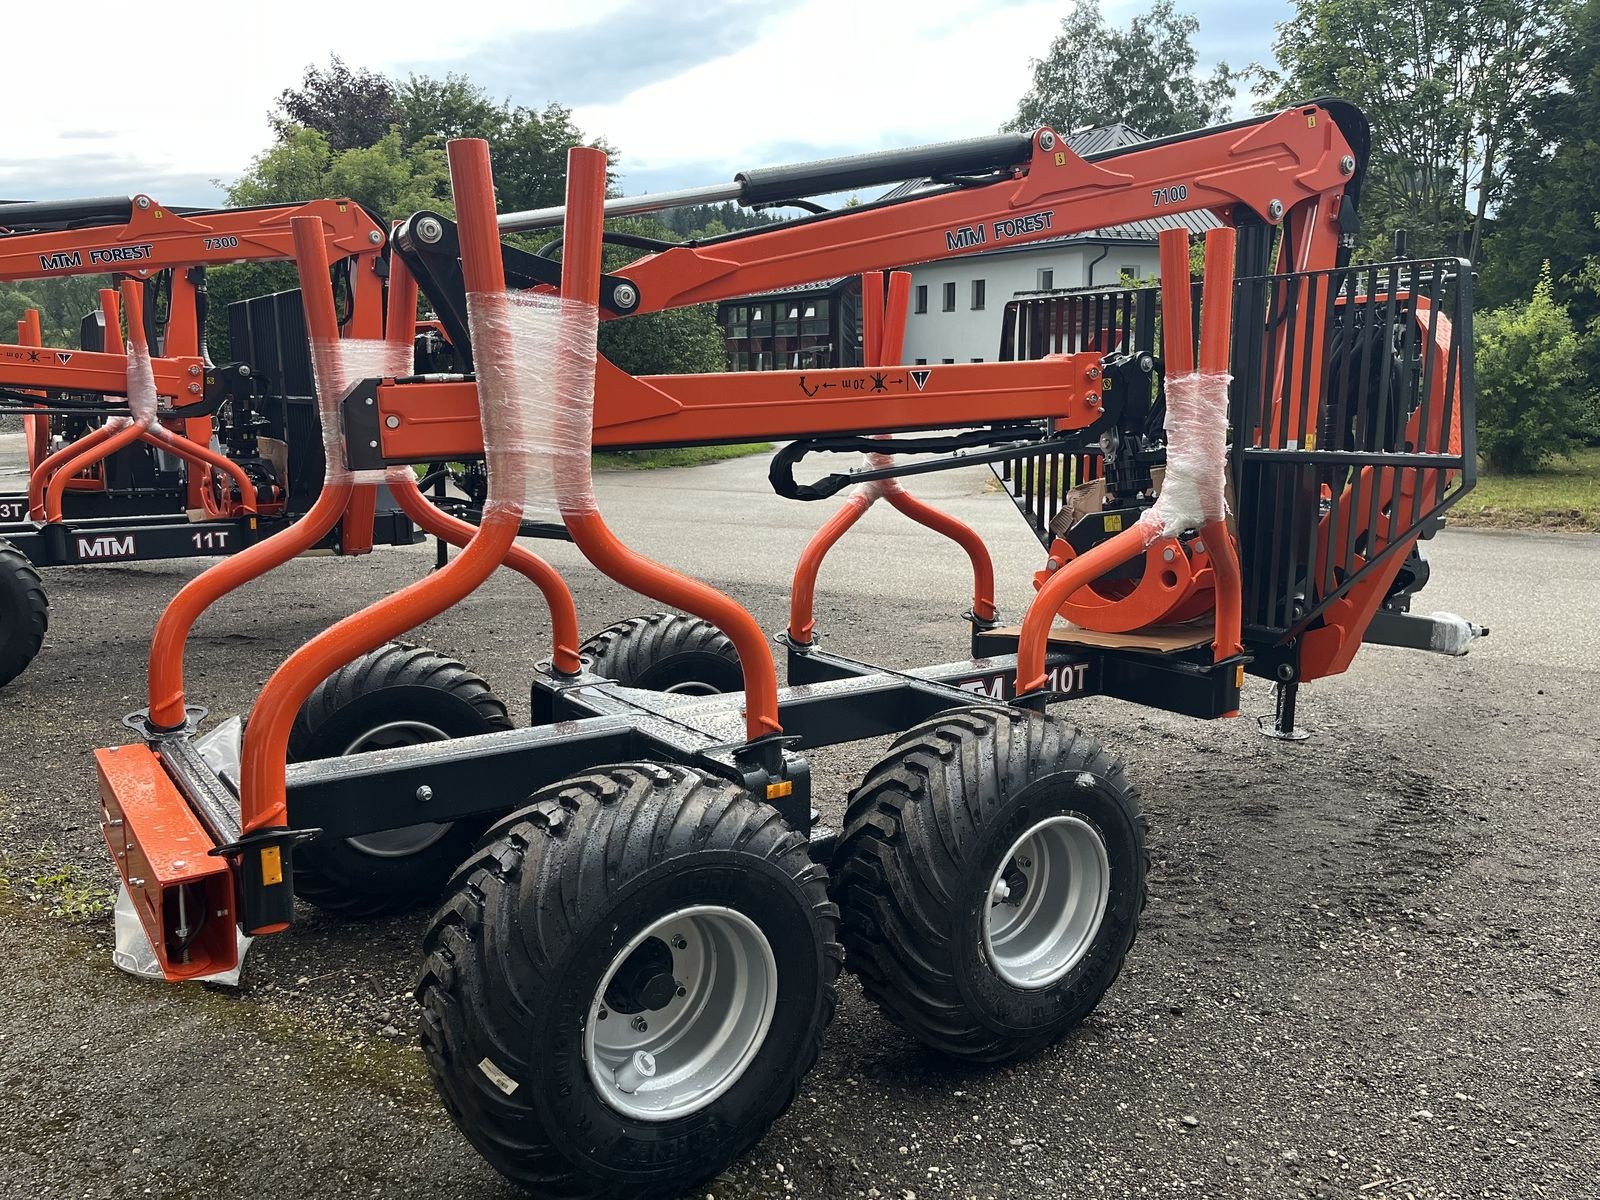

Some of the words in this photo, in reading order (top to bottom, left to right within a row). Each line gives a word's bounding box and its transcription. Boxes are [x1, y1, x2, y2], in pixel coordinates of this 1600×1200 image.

[1152, 184, 1188, 207] 7100
[945, 224, 987, 251] MTM
[993, 210, 1055, 241] FOREST
[204, 236, 239, 251] 7300
[39, 252, 83, 271] MTM
[89, 244, 154, 265] FOREST
[841, 379, 851, 388] m
[853, 378, 865, 390] 20
[78, 535, 136, 558] MTM
[192, 531, 229, 549] 11T
[1048, 663, 1089, 693] 10T
